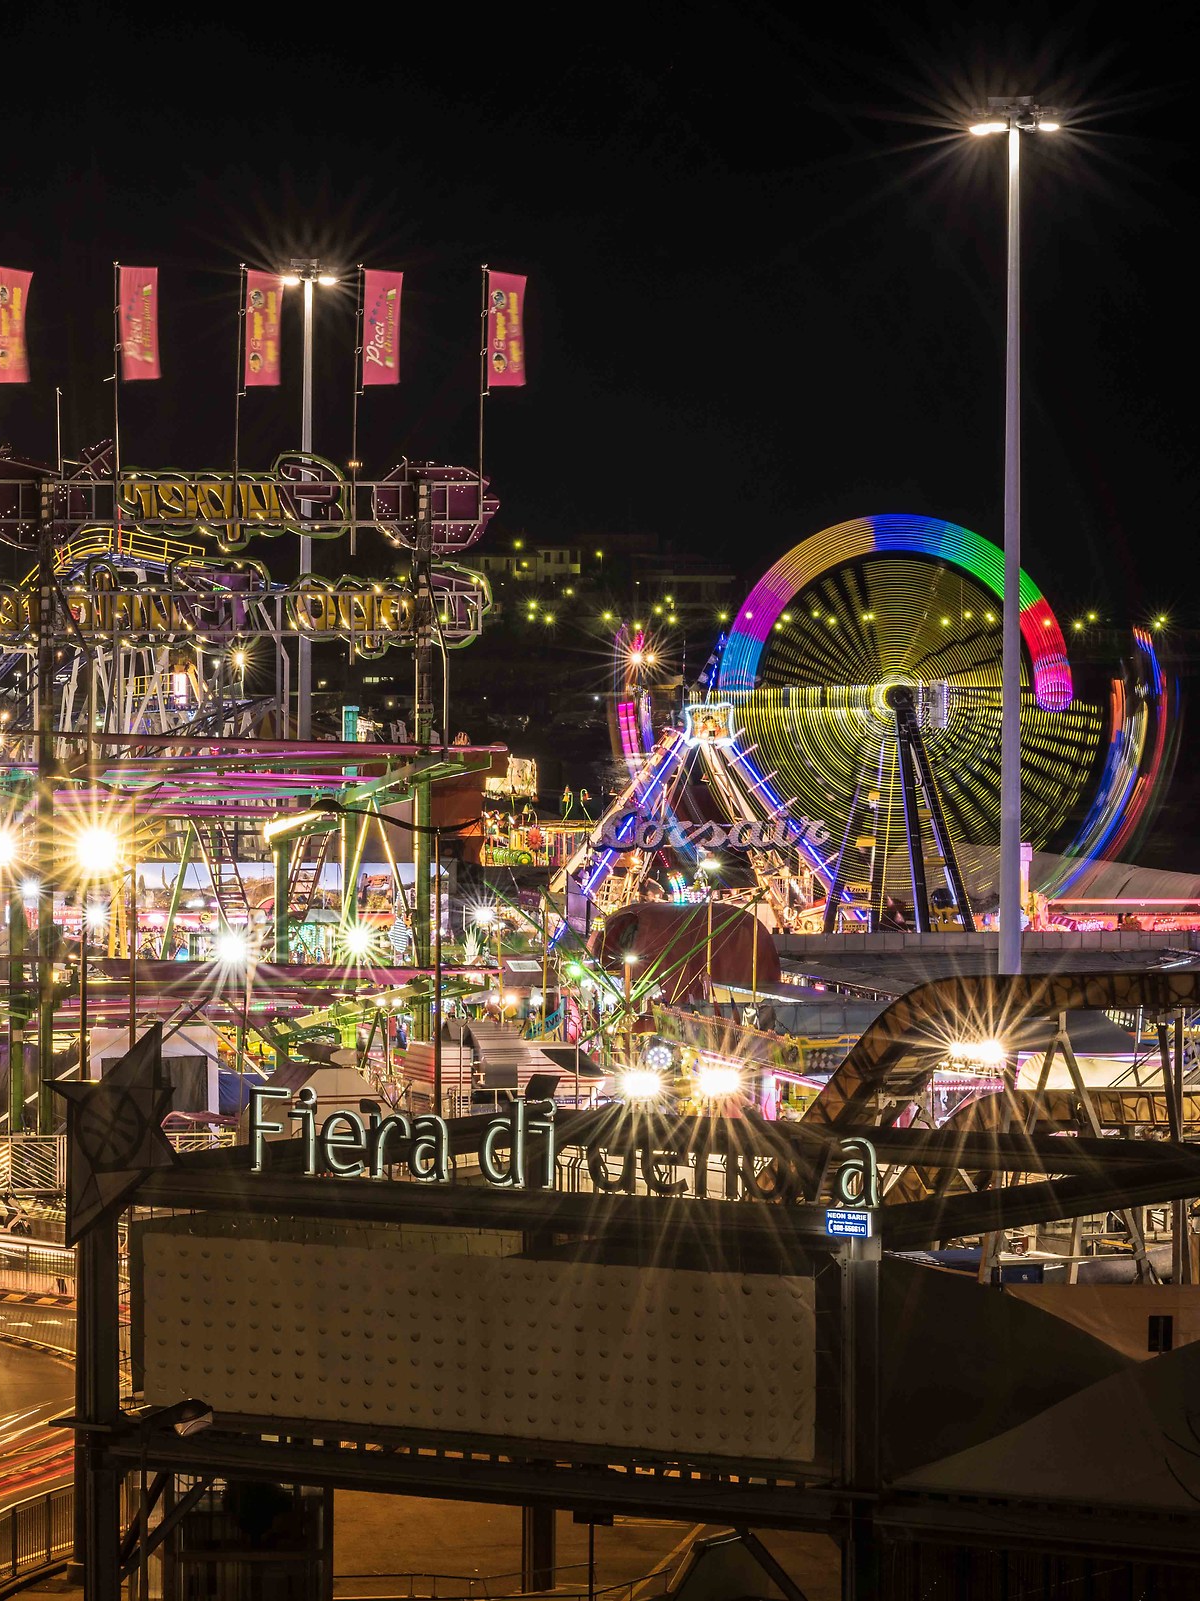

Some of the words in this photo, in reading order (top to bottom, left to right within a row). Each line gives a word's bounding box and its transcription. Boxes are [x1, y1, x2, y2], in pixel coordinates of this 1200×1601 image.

[366, 321, 385, 366] Picci
[592, 809, 831, 853] Corsair
[249, 1086, 449, 1182] Fiera
[479, 1098, 557, 1190] di
[847, 1213, 867, 1221] SARIE
